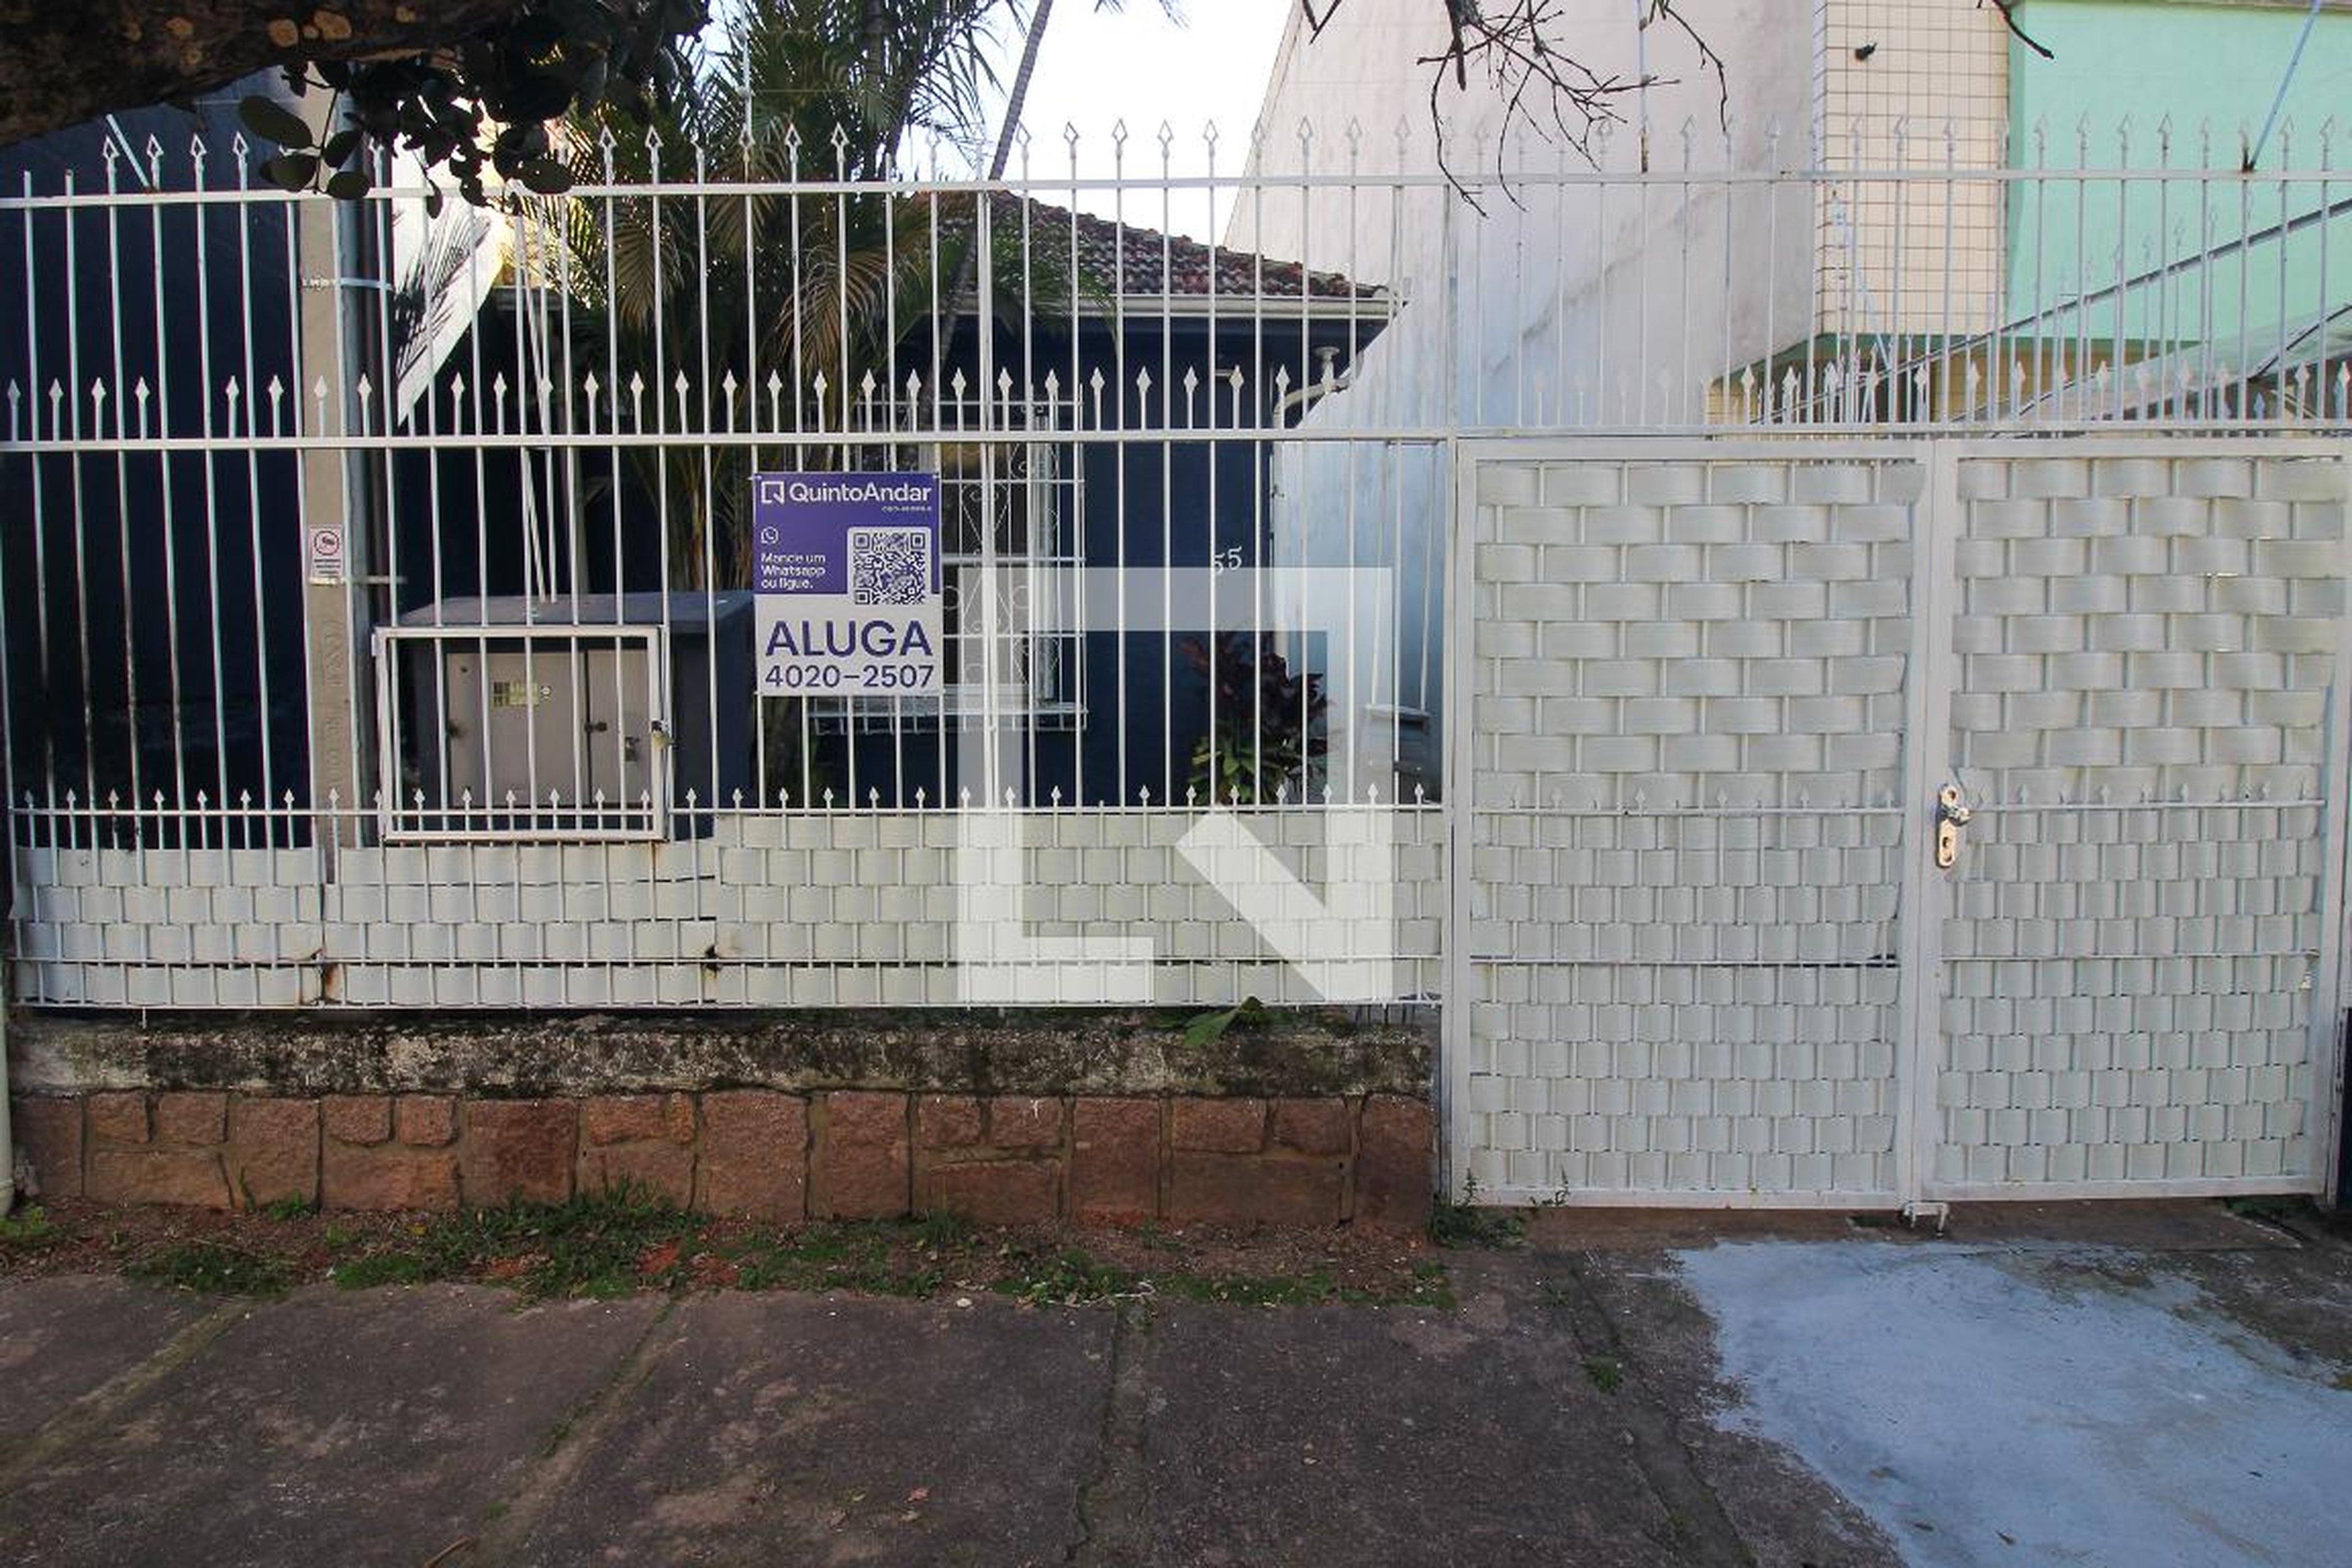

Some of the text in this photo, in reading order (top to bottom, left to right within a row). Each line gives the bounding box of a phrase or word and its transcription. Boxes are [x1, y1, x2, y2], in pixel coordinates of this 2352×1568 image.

[789, 482, 932, 502] QuintoAndar
[761, 579, 777, 588] ou
[765, 620, 933, 657] ALUGA
[765, 665, 934, 688] 4020-2507
